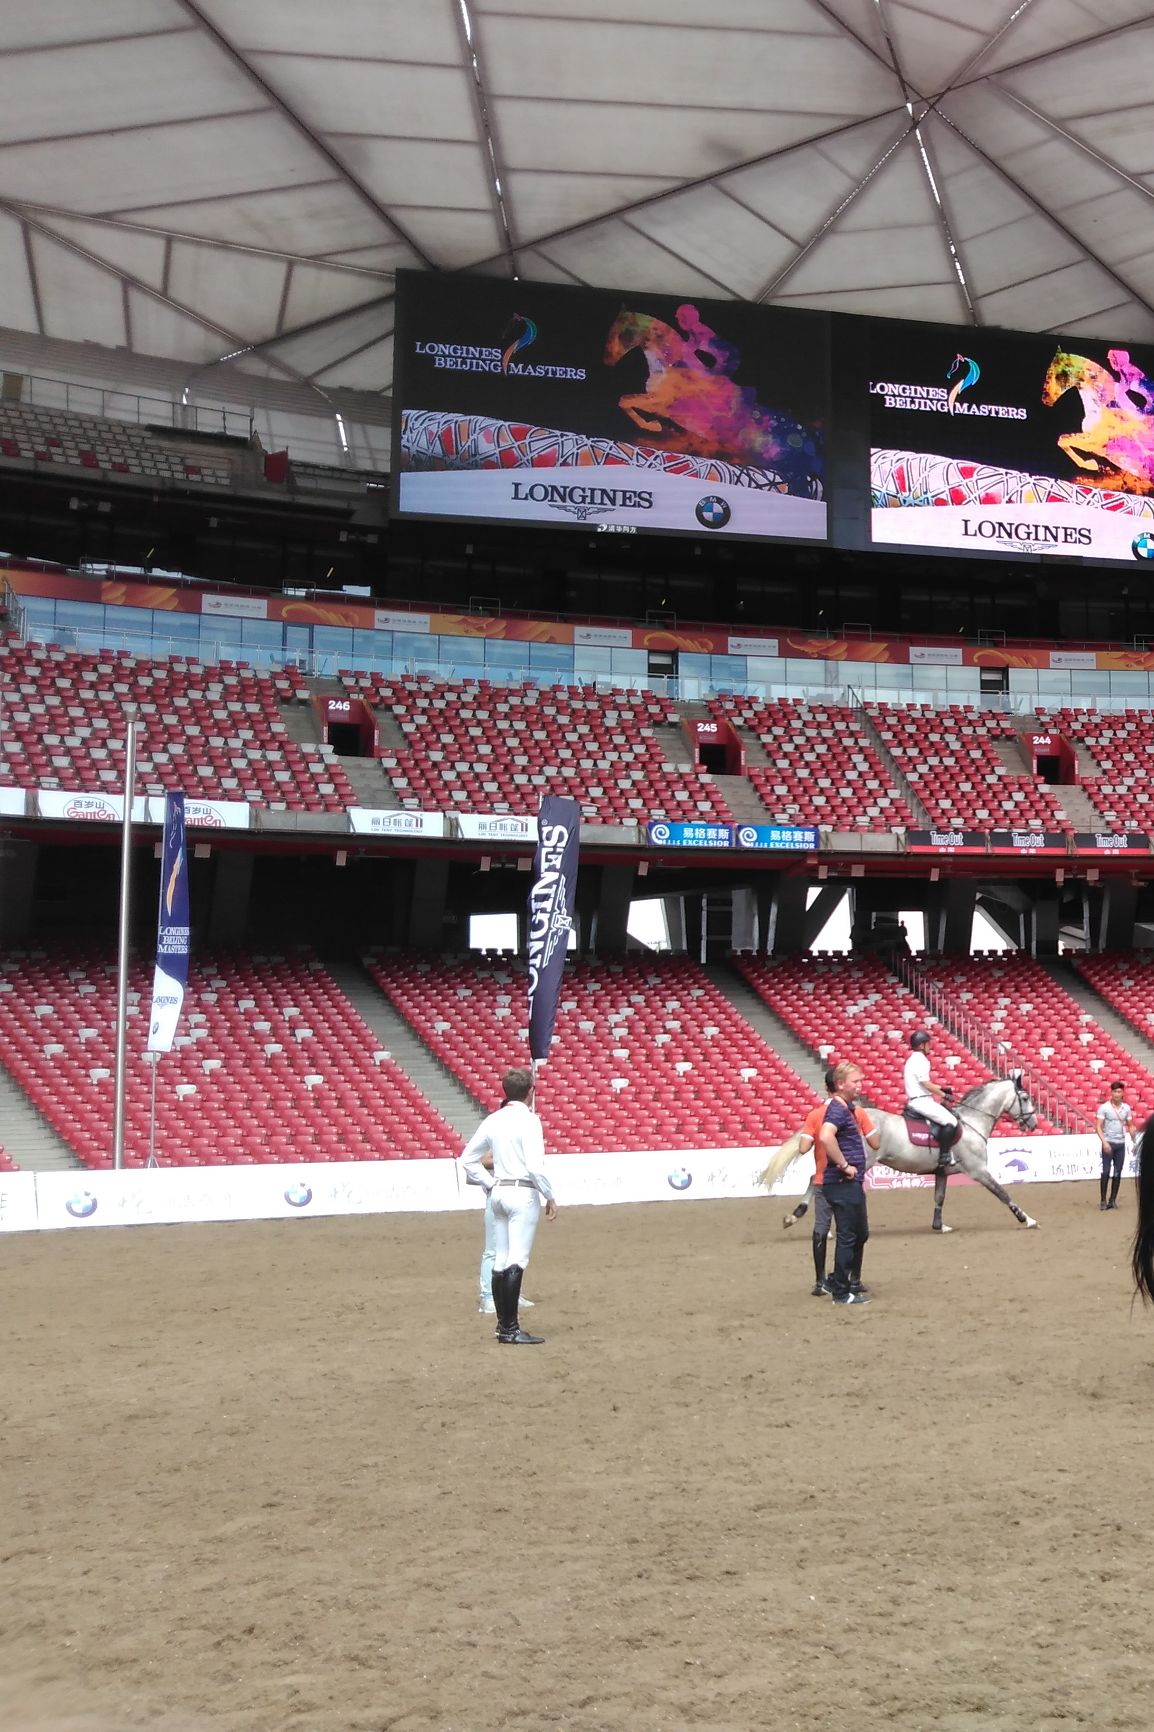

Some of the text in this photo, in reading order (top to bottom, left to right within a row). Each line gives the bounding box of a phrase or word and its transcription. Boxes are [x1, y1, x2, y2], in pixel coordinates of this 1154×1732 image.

[415, 341, 502, 360] LONGINES
[434, 355, 587, 380] BEIJING MASTERS
[870, 381, 948, 400] LONGINES
[885, 395, 1027, 420] BEIJING MASTERS
[511, 481, 653, 510] LONGINES
[698, 496, 728, 509] BMW
[962, 518, 1093, 546] LONGINES
[328, 700, 350, 711] 246
[697, 722, 718, 733] 245
[1032, 736, 1052, 745] 244
[74, 800, 104, 809] 百岁山
[528, 824, 569, 1020] ONGINES
